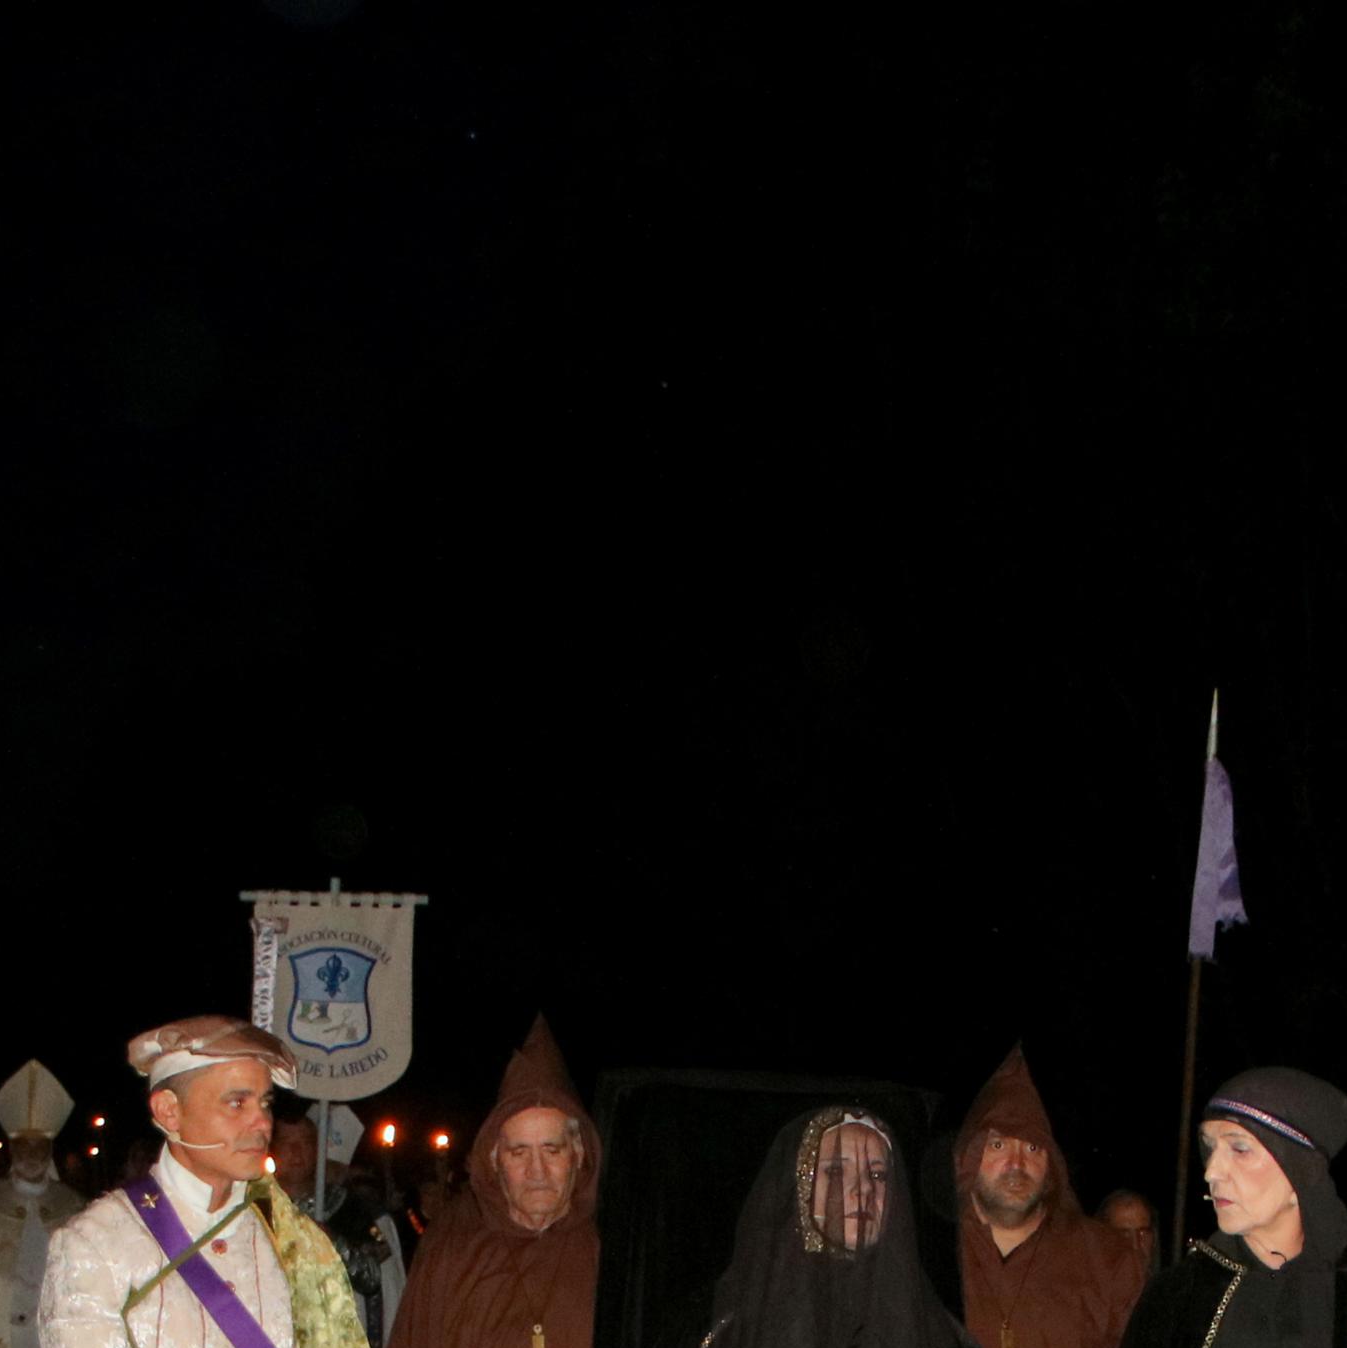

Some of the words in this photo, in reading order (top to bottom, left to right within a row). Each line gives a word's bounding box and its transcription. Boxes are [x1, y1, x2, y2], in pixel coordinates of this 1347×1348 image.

[277, 928, 338, 958] SOCIACIÓN
[341, 930, 392, 965] CULTURAL
[303, 1060, 323, 1077] DE
[329, 1046, 389, 1078] LAREDO
